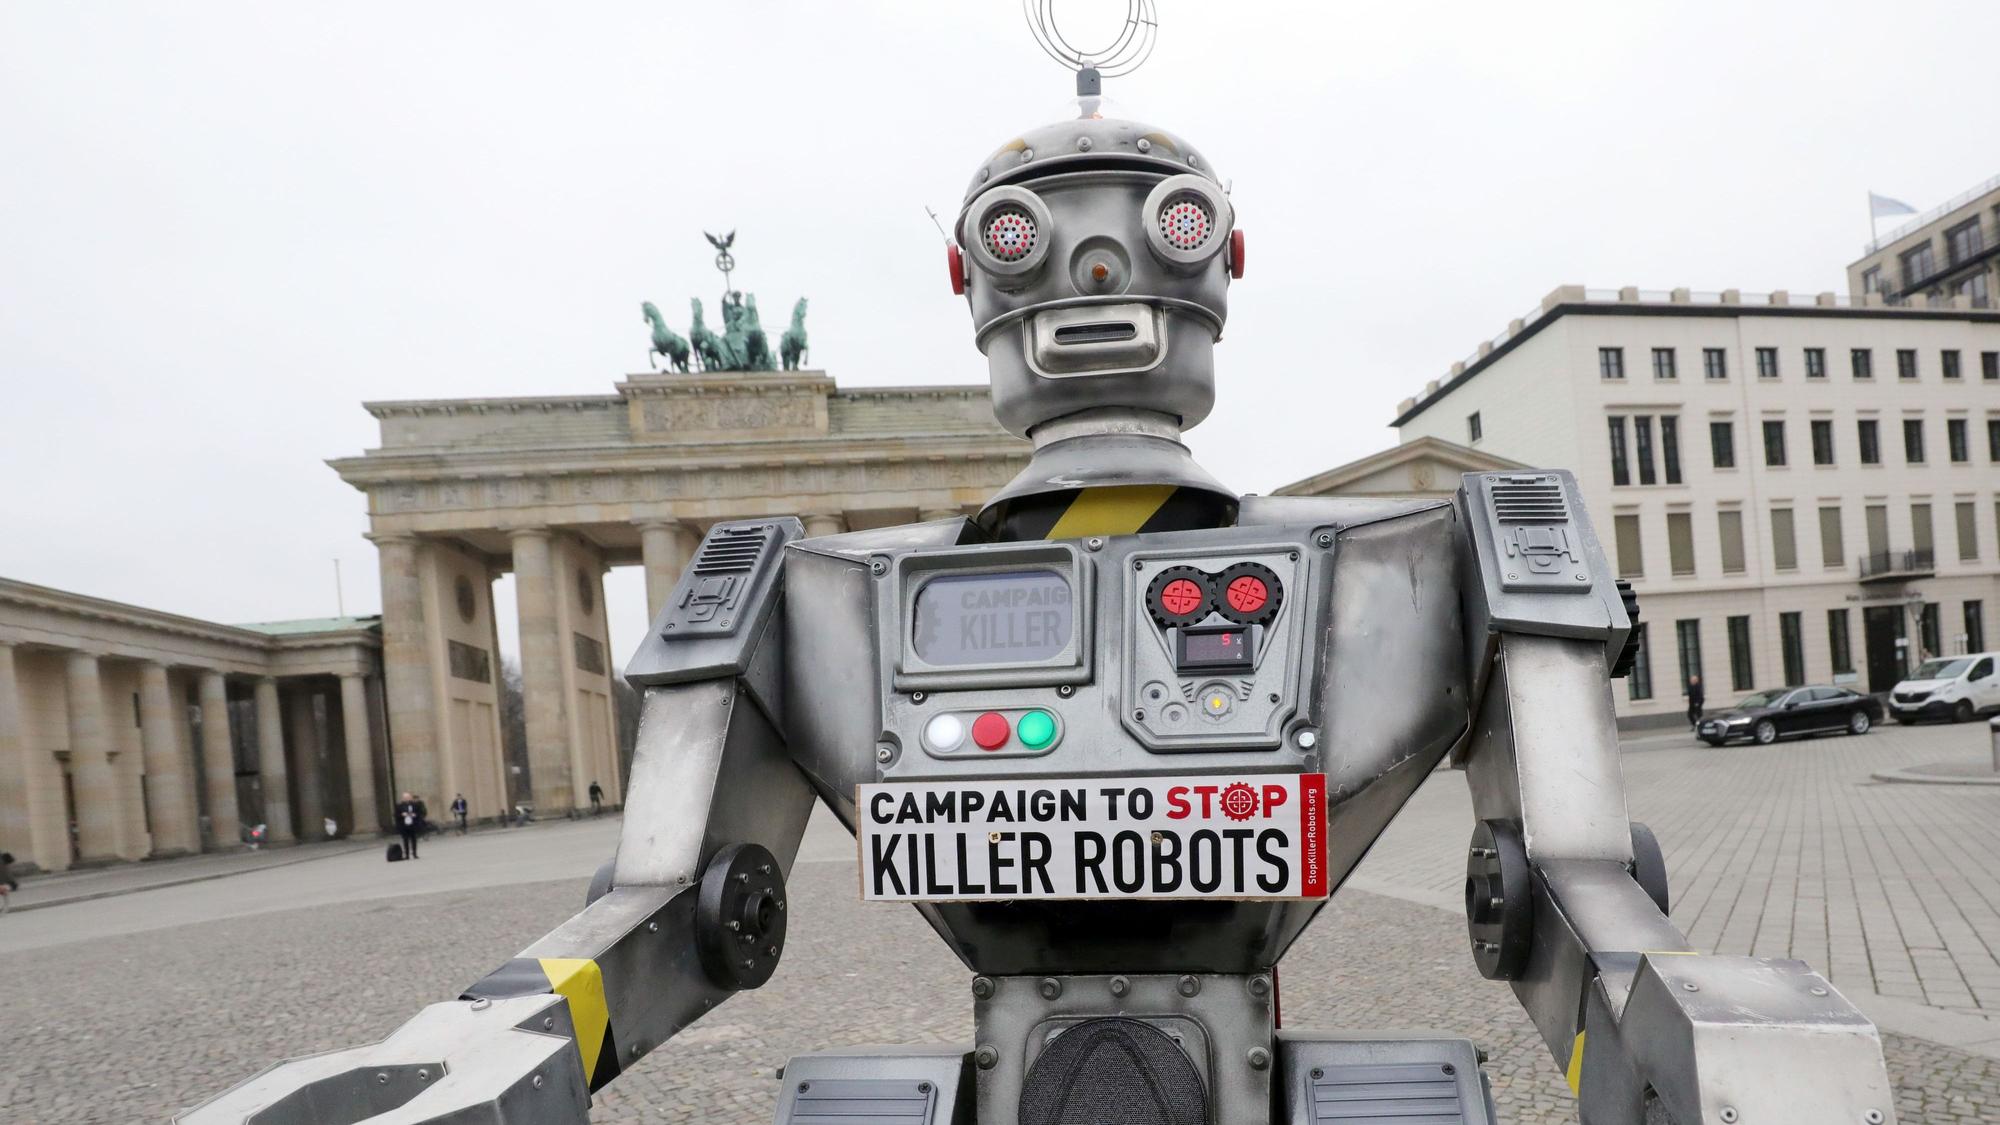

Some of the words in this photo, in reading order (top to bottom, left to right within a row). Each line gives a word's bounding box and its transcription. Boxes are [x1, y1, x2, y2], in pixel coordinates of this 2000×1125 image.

[961, 586, 1071, 609] CAMPAIG
[960, 610, 1062, 650] KILLER
[1222, 633, 1232, 646] 5
[870, 789, 1086, 824] CAMPAIGN
[1100, 787, 1154, 821] TO
[1166, 781, 1288, 822] STOP
[1307, 788, 1317, 885] StopKillerRobots.org
[871, 831, 1055, 895] KILLER
[1074, 828, 1290, 894] ROBOTS
